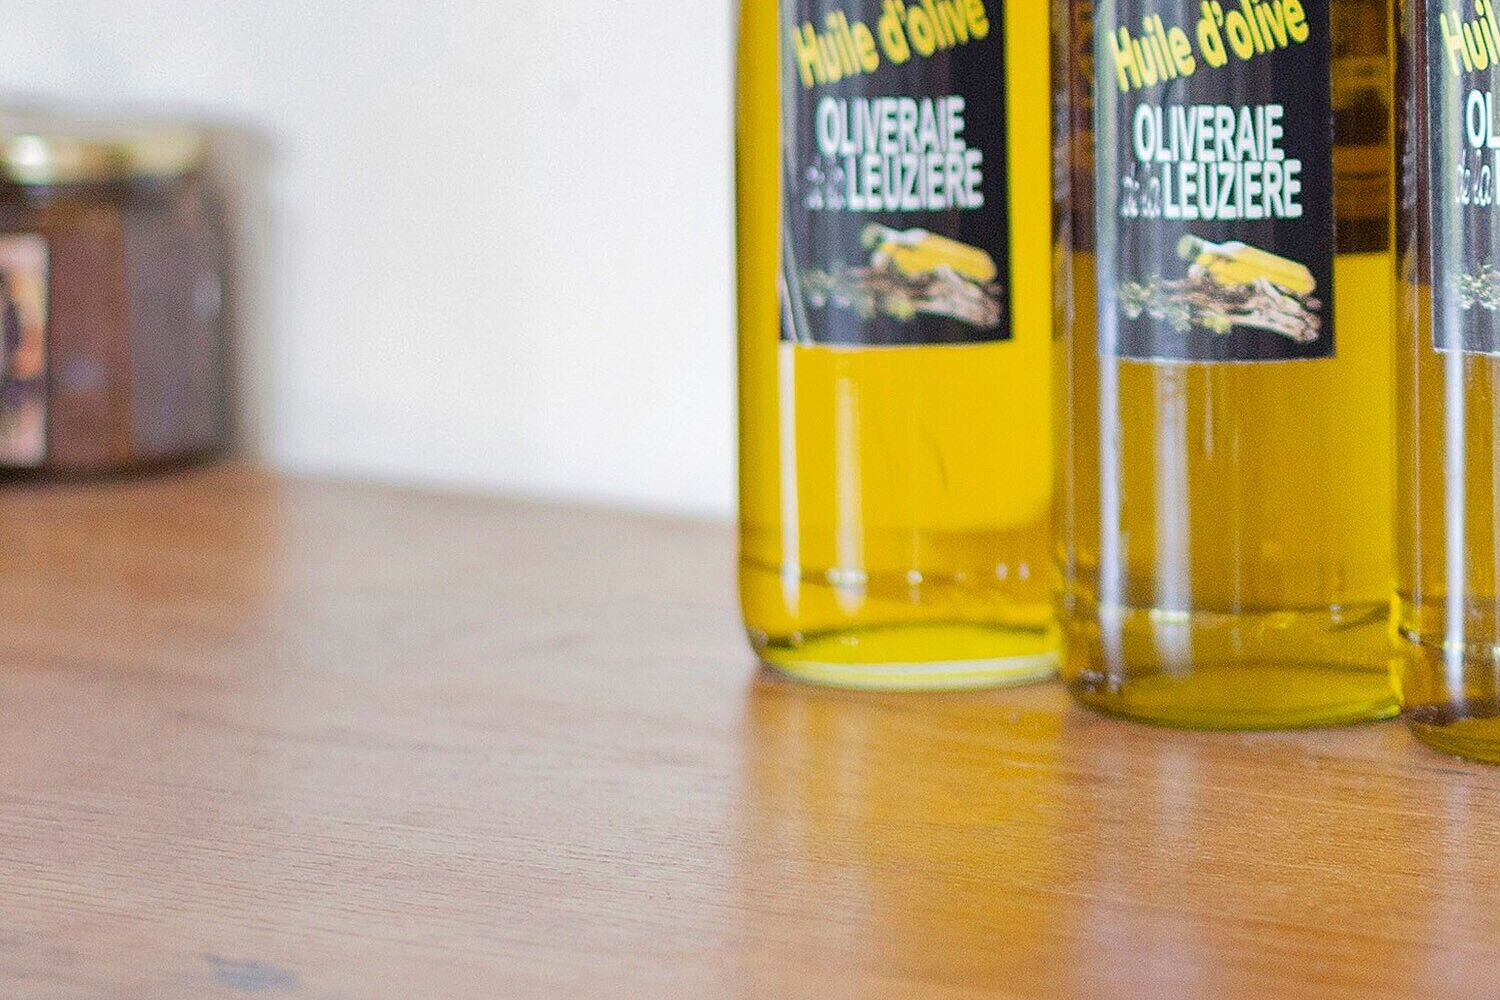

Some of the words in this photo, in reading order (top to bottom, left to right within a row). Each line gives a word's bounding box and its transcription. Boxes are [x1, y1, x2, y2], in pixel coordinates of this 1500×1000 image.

[794, 10, 879, 88] Huile
[1110, 13, 1196, 92] Huile
[817, 96, 965, 155] OLIVERAIE
[1134, 103, 1284, 162] OLIVERAIE
[847, 149, 984, 211] LEUZIERE
[1163, 159, 1303, 219] LEUZIERE
